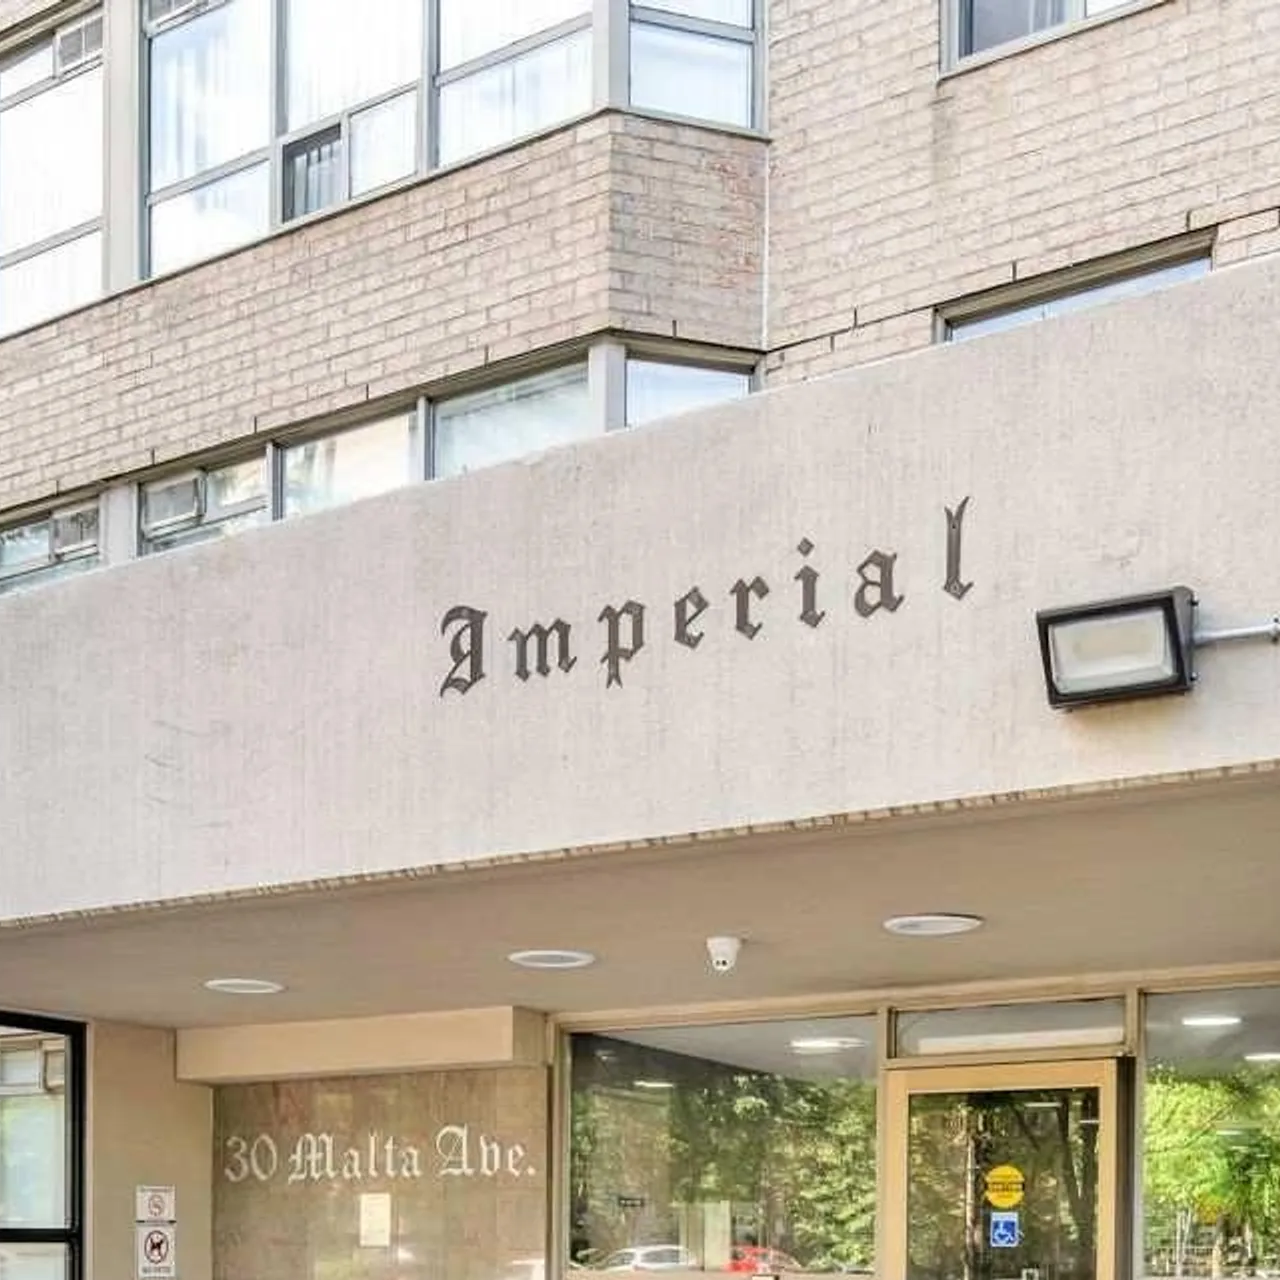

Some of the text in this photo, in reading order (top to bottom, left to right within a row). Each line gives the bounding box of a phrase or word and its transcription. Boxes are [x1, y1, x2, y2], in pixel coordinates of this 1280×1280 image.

[439, 496, 976, 698] Imperial
[224, 1122, 538, 1184] 30 Malta Ave.
